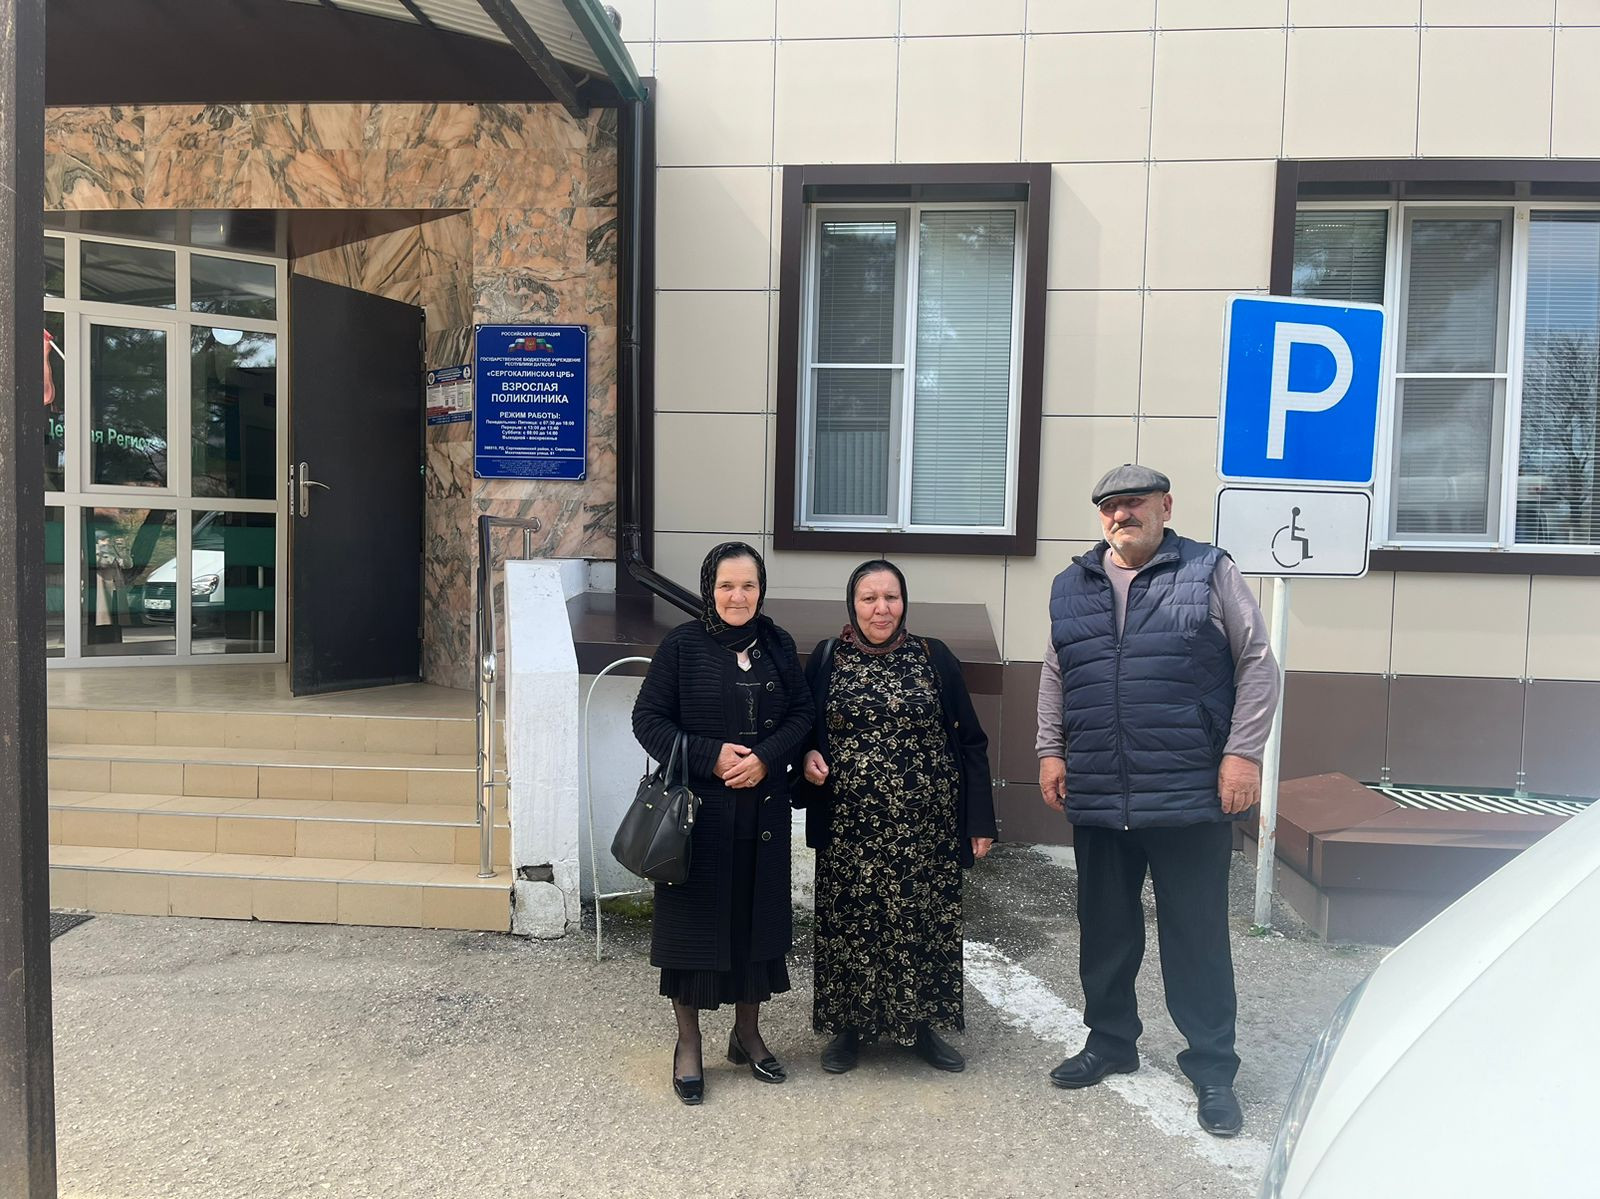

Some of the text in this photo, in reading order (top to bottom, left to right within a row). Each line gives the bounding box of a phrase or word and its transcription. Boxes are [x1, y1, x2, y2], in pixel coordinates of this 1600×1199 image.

[502, 382, 558, 392] ВЗРОСЛАЯ
[1266, 321, 1354, 460] P
[492, 393, 569, 404] ПОЛИКЛИНИКА
